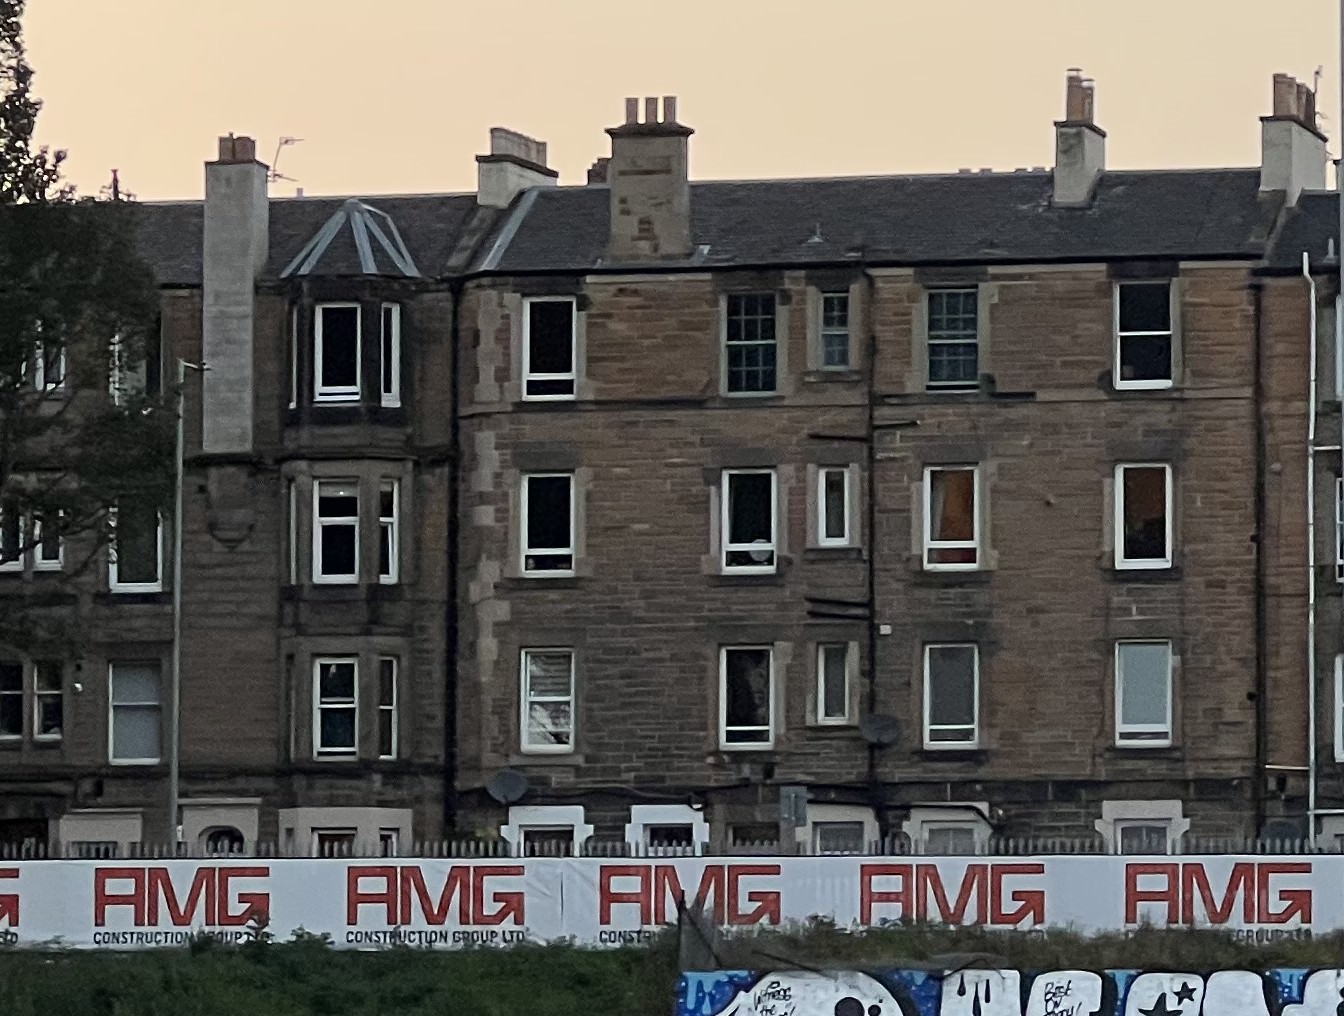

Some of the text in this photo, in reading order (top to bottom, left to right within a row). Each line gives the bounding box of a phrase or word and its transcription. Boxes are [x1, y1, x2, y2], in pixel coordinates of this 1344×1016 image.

[94, 867, 270, 926] AMG
[347, 866, 525, 925] AMG
[600, 864, 781, 925] AMG
[860, 863, 1045, 924] AMG
[1125, 862, 1311, 924] AMG
[93, 932, 193, 945] CONSTRUCTION
[346, 931, 524, 944] CONSTRUCTION GROUP LTD
